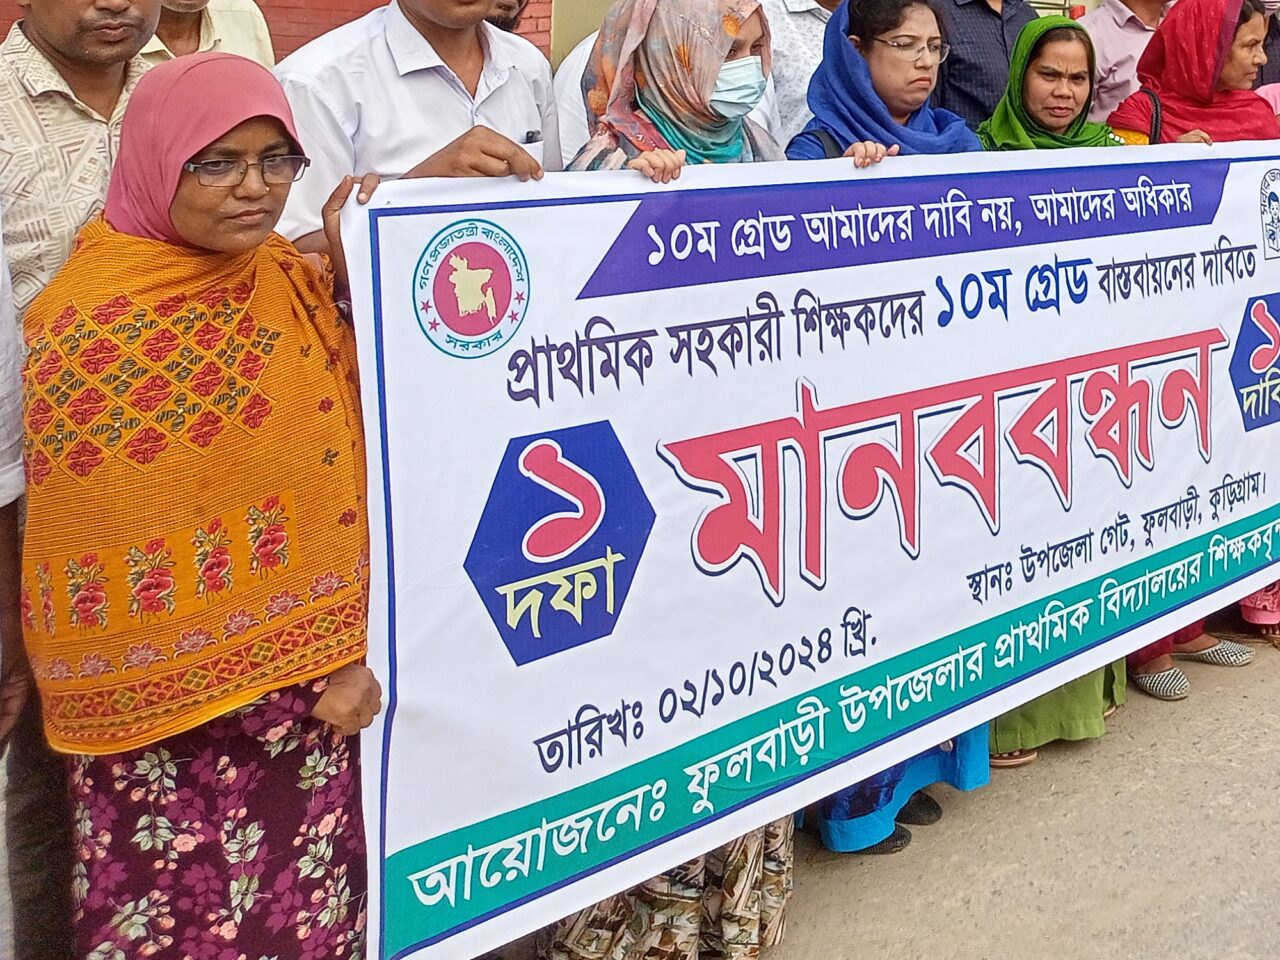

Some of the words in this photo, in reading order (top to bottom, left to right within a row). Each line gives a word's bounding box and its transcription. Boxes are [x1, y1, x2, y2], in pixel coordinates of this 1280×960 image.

[481, 226, 526, 283] বাংলাদেশ
[646, 220, 721, 267] ১০ম
[730, 210, 796, 261] গ্রেড
[802, 202, 915, 250] আমাদের
[920, 188, 972, 242] দাবি
[977, 194, 1023, 240] নয়,
[1029, 186, 1117, 228] আমাদের
[1120, 174, 1194, 219] অধিকার
[444, 329, 504, 352] সরকার
[506, 315, 658, 409] প্রাথমিক
[665, 290, 786, 378] সহকারী
[791, 287, 926, 360] শিক্ষকদের
[935, 267, 1013, 329] ১০ম
[1024, 252, 1095, 317] গ্রেড
[1096, 251, 1197, 307] বাস্তবায়নের
[1201, 234, 1259, 287] দাবিতে
[519, 438, 606, 563] ১
[657, 326, 1230, 606] মানববন্ধন
[1019, 530, 1093, 583] উপজেলা
[1099, 514, 1137, 555] গেট,
[1141, 484, 1203, 549] ফুলবাড়ী,
[1210, 470, 1268, 523] কুড়িগ্রাম।
[494, 546, 627, 640] দফা
[533, 697, 645, 776] তারিখঃ
[658, 624, 833, 729] ০২/১০/২০২৪
[841, 603, 878, 661] খ্রি.
[682, 693, 832, 816] ফুলবাড়ী
[838, 639, 987, 735] উপজেলার
[994, 591, 1094, 668] প্রাথমিক
[1098, 555, 1203, 627] বিদ্যালয়ের
